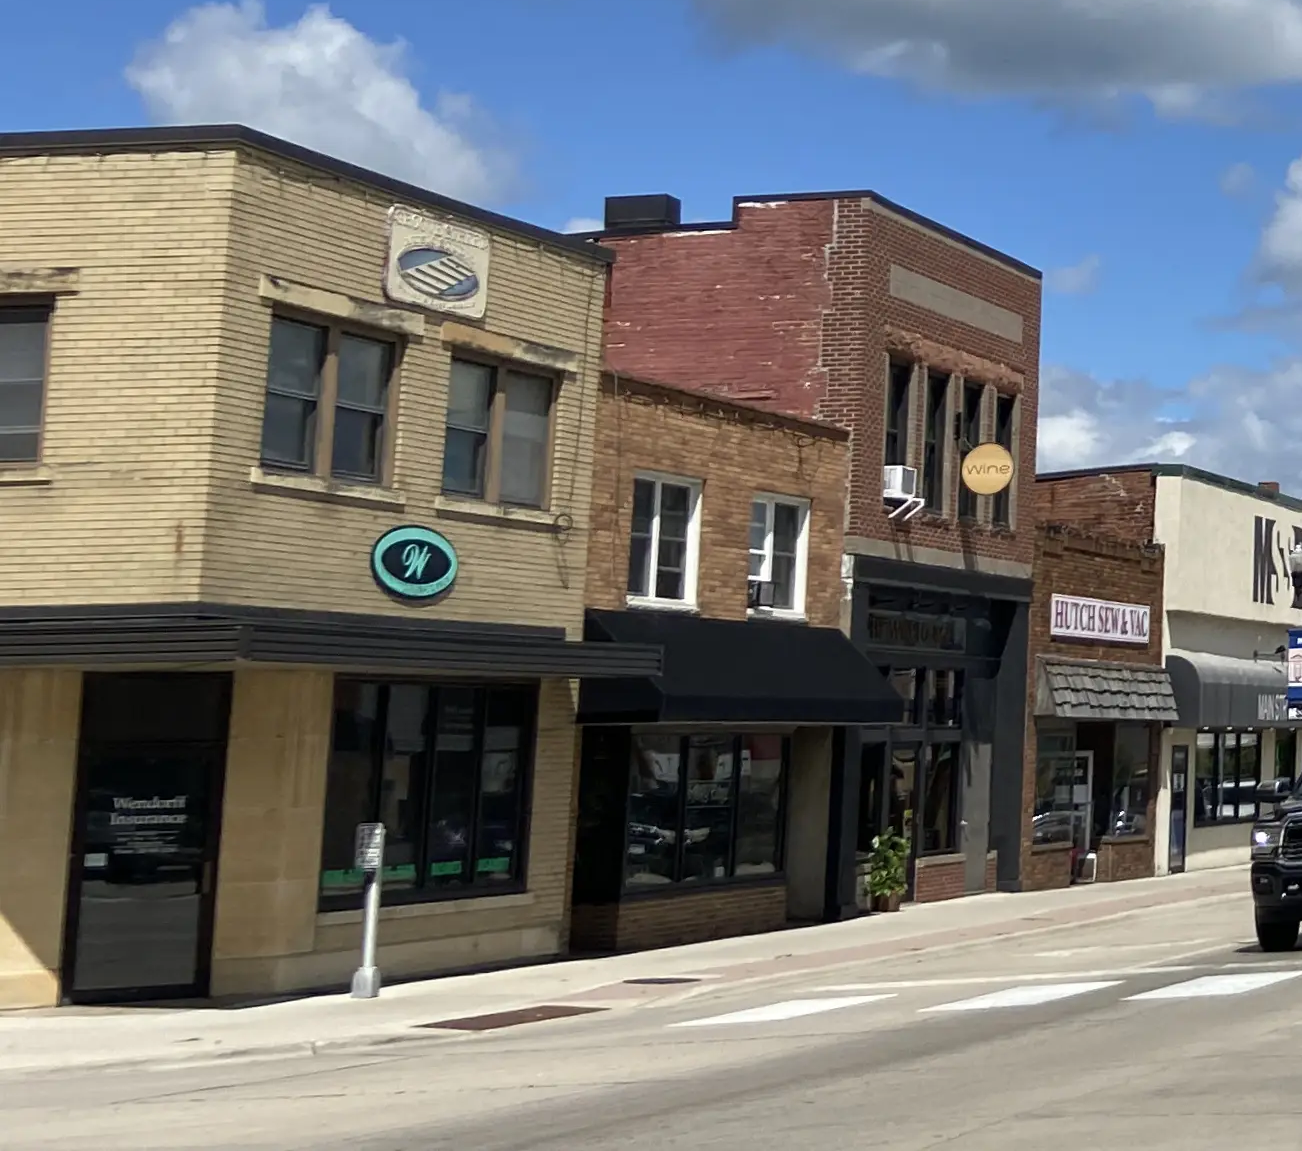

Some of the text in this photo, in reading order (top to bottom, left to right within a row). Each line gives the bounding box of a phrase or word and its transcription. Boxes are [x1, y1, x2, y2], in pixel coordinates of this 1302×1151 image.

[967, 463, 1010, 475] wine
[402, 544, 432, 580] W
[1055, 600, 1148, 637] HUTCH SEW & VAC
